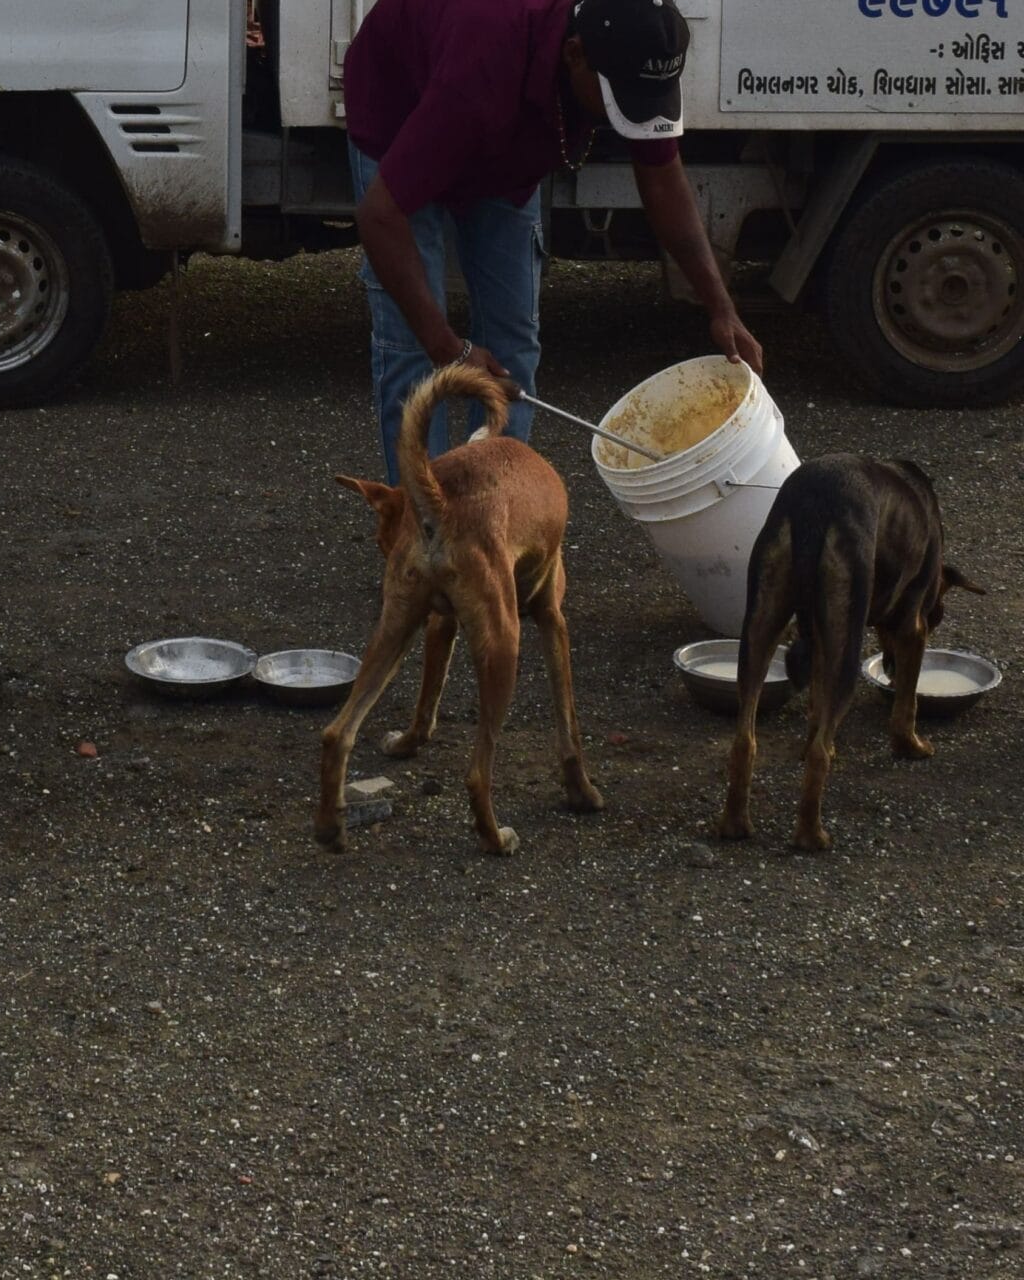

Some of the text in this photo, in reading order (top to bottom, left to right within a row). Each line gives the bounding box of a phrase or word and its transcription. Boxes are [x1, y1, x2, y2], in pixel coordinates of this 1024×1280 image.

[642, 52, 683, 71] AMIRI
[738, 68, 818, 95] વિમલનગર
[653, 124, 674, 132] AMIRI
